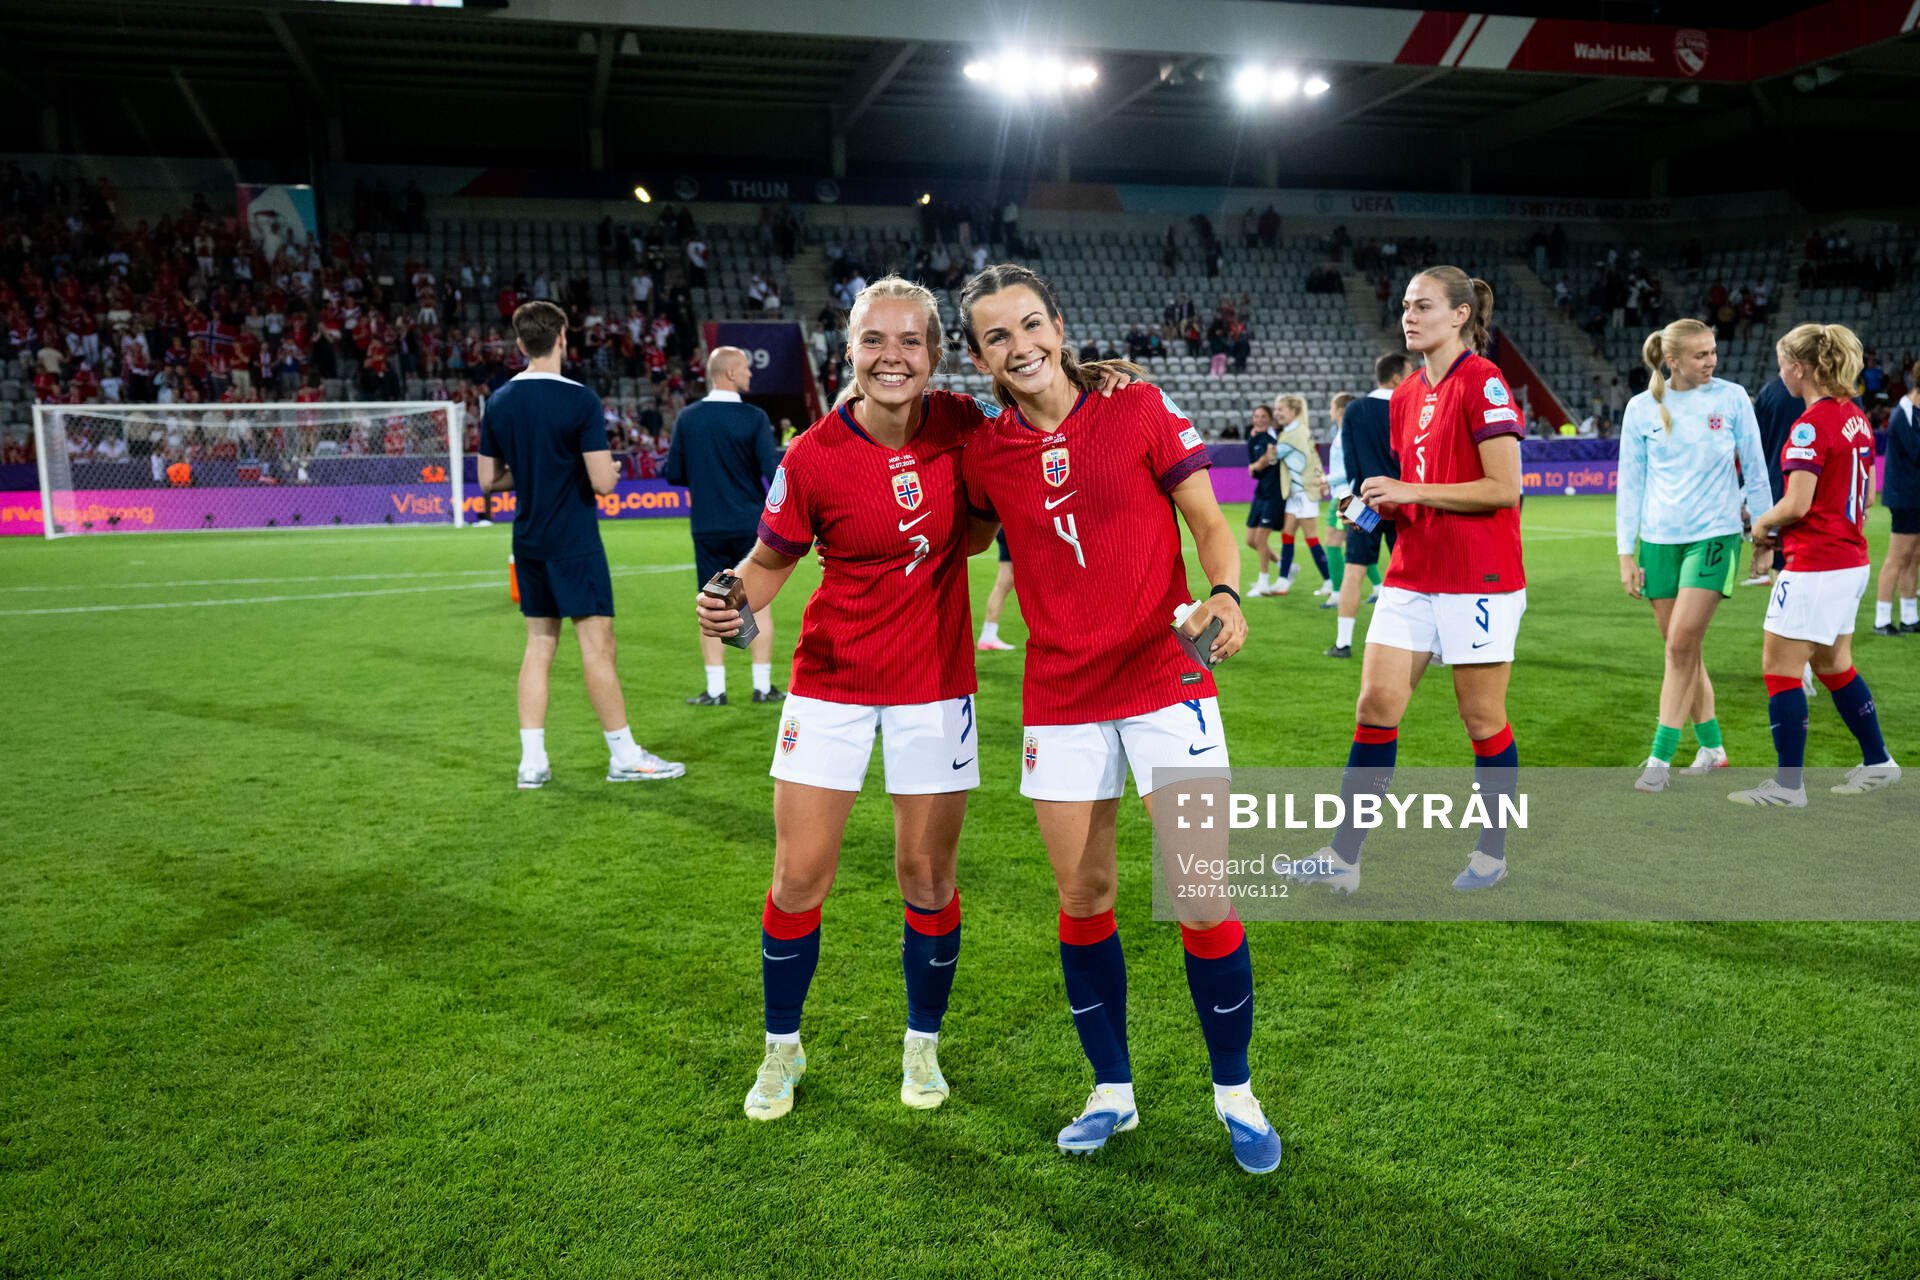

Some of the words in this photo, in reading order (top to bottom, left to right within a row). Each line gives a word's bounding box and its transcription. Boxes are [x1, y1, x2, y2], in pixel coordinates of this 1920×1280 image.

[1574, 42, 1616, 60] Wahri
[1617, 46, 1655, 63] Liebi.
[727, 179, 789, 198] THUN
[1351, 196, 1394, 213] UEFA
[1415, 446, 1425, 483] 5
[1545, 471, 1564, 487] to
[1567, 468, 1604, 487] take
[391, 493, 444, 514] Visit
[1053, 513, 1086, 569] 4
[1705, 541, 1724, 567] 12
[1476, 598, 1489, 634] 5
